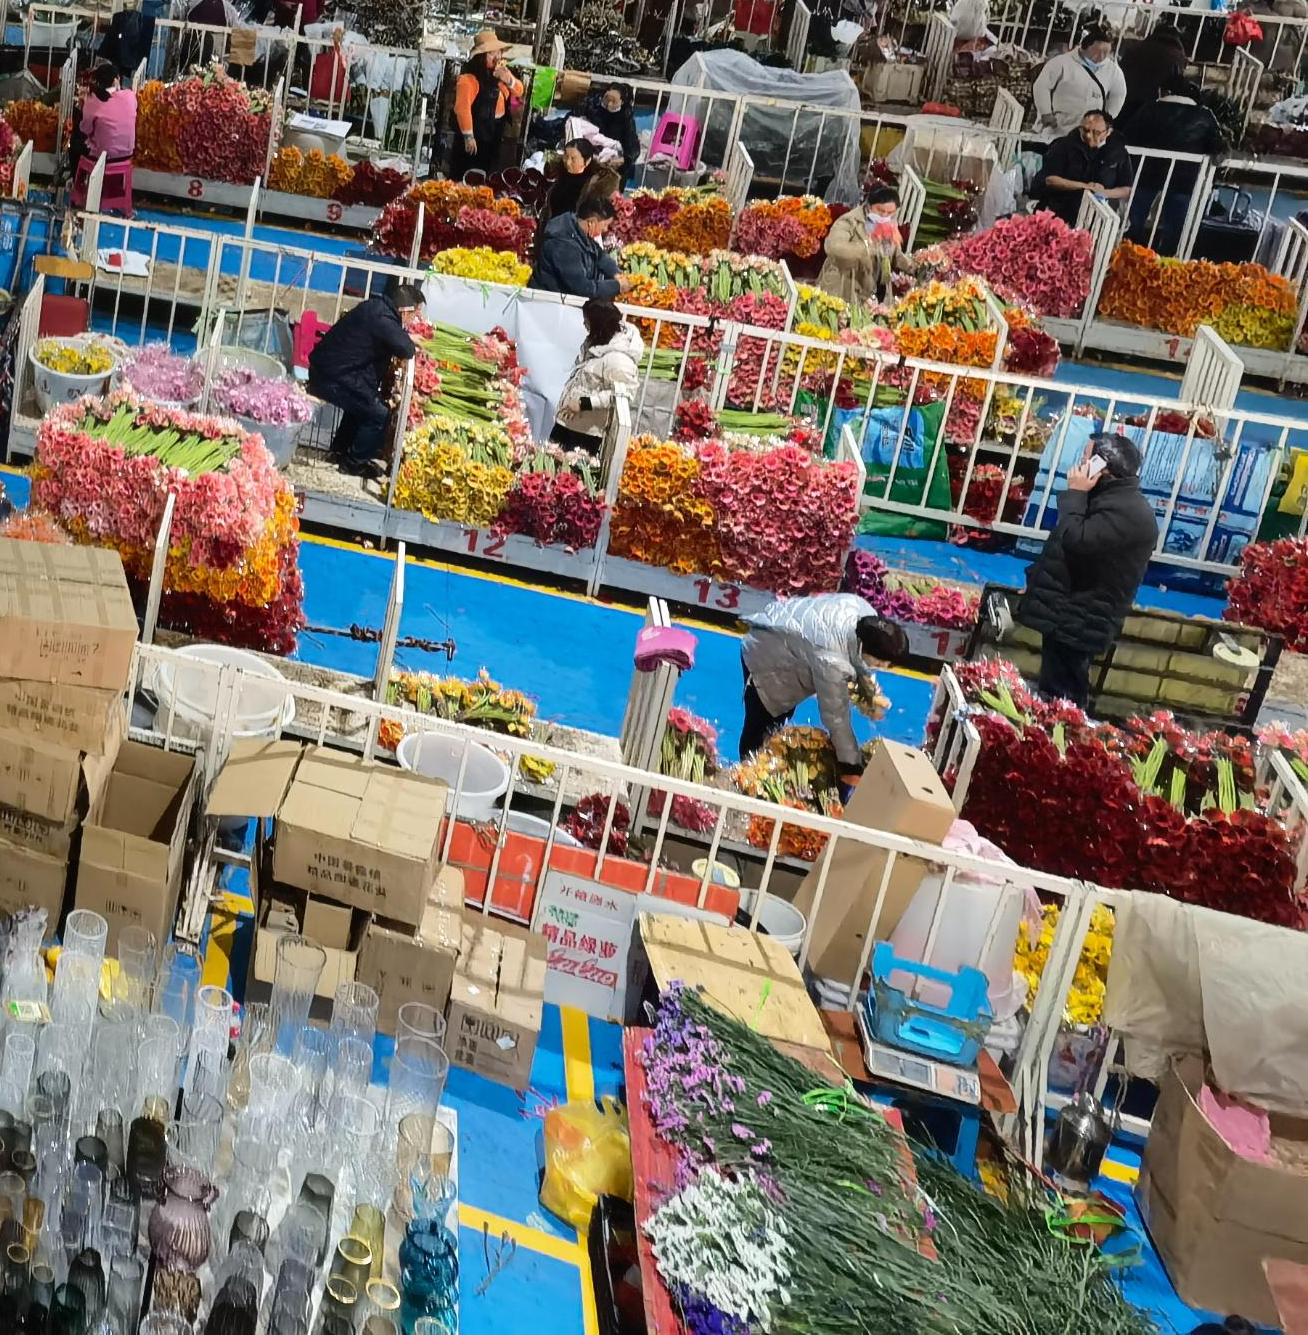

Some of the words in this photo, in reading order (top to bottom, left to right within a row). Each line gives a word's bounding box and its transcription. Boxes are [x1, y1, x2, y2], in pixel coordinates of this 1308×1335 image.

[187, 179, 204, 198] 8
[463, 528, 507, 558] 12
[693, 578, 741, 610] 13
